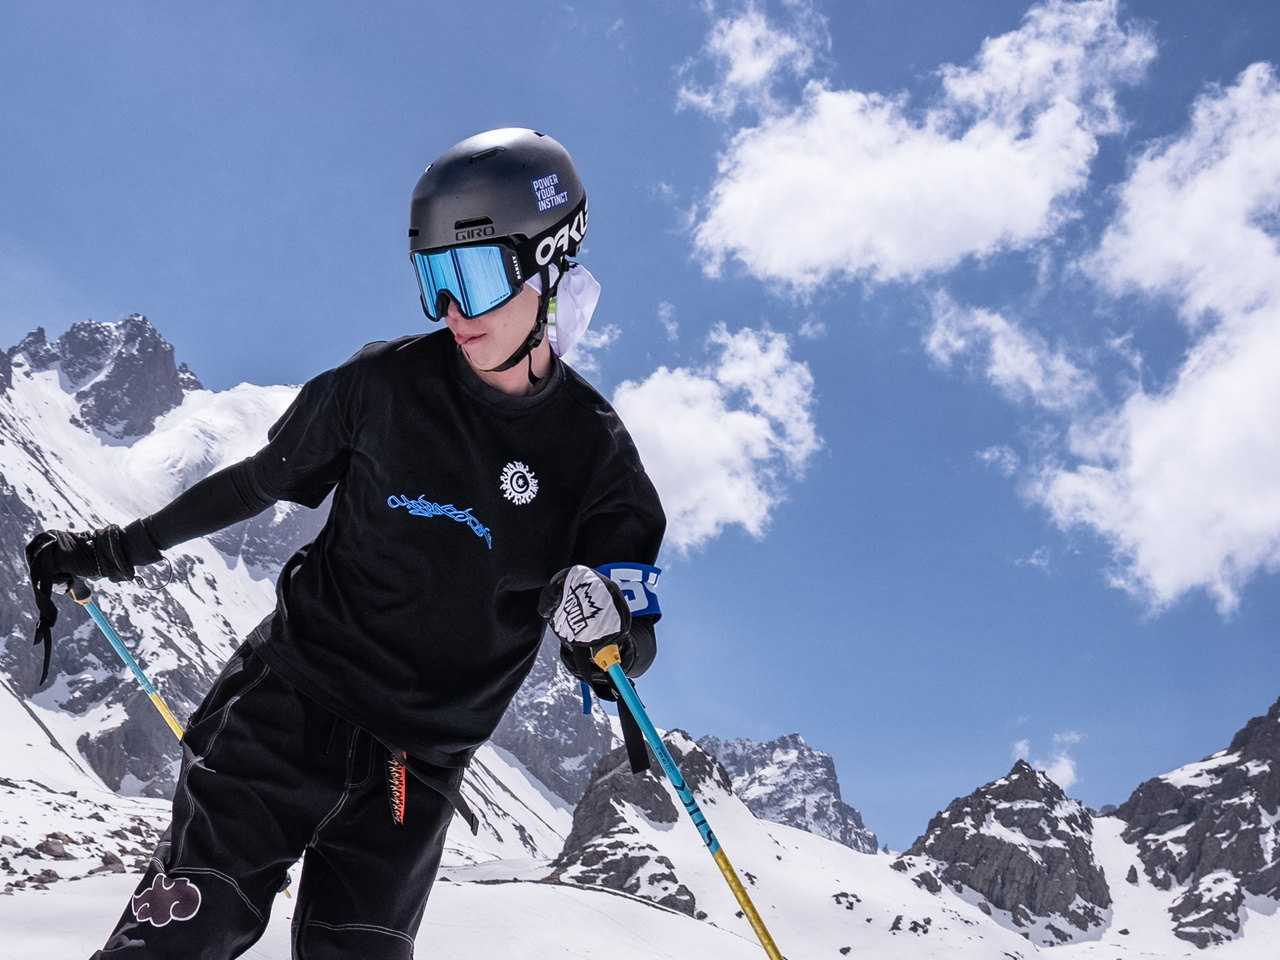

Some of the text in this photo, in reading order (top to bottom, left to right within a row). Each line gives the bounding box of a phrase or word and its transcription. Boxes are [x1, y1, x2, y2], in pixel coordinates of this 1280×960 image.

[532, 173, 559, 191] POWER
[535, 185, 556, 201] YOUR
[537, 191, 568, 212] INSTINCT
[455, 225, 495, 241] GIRO
